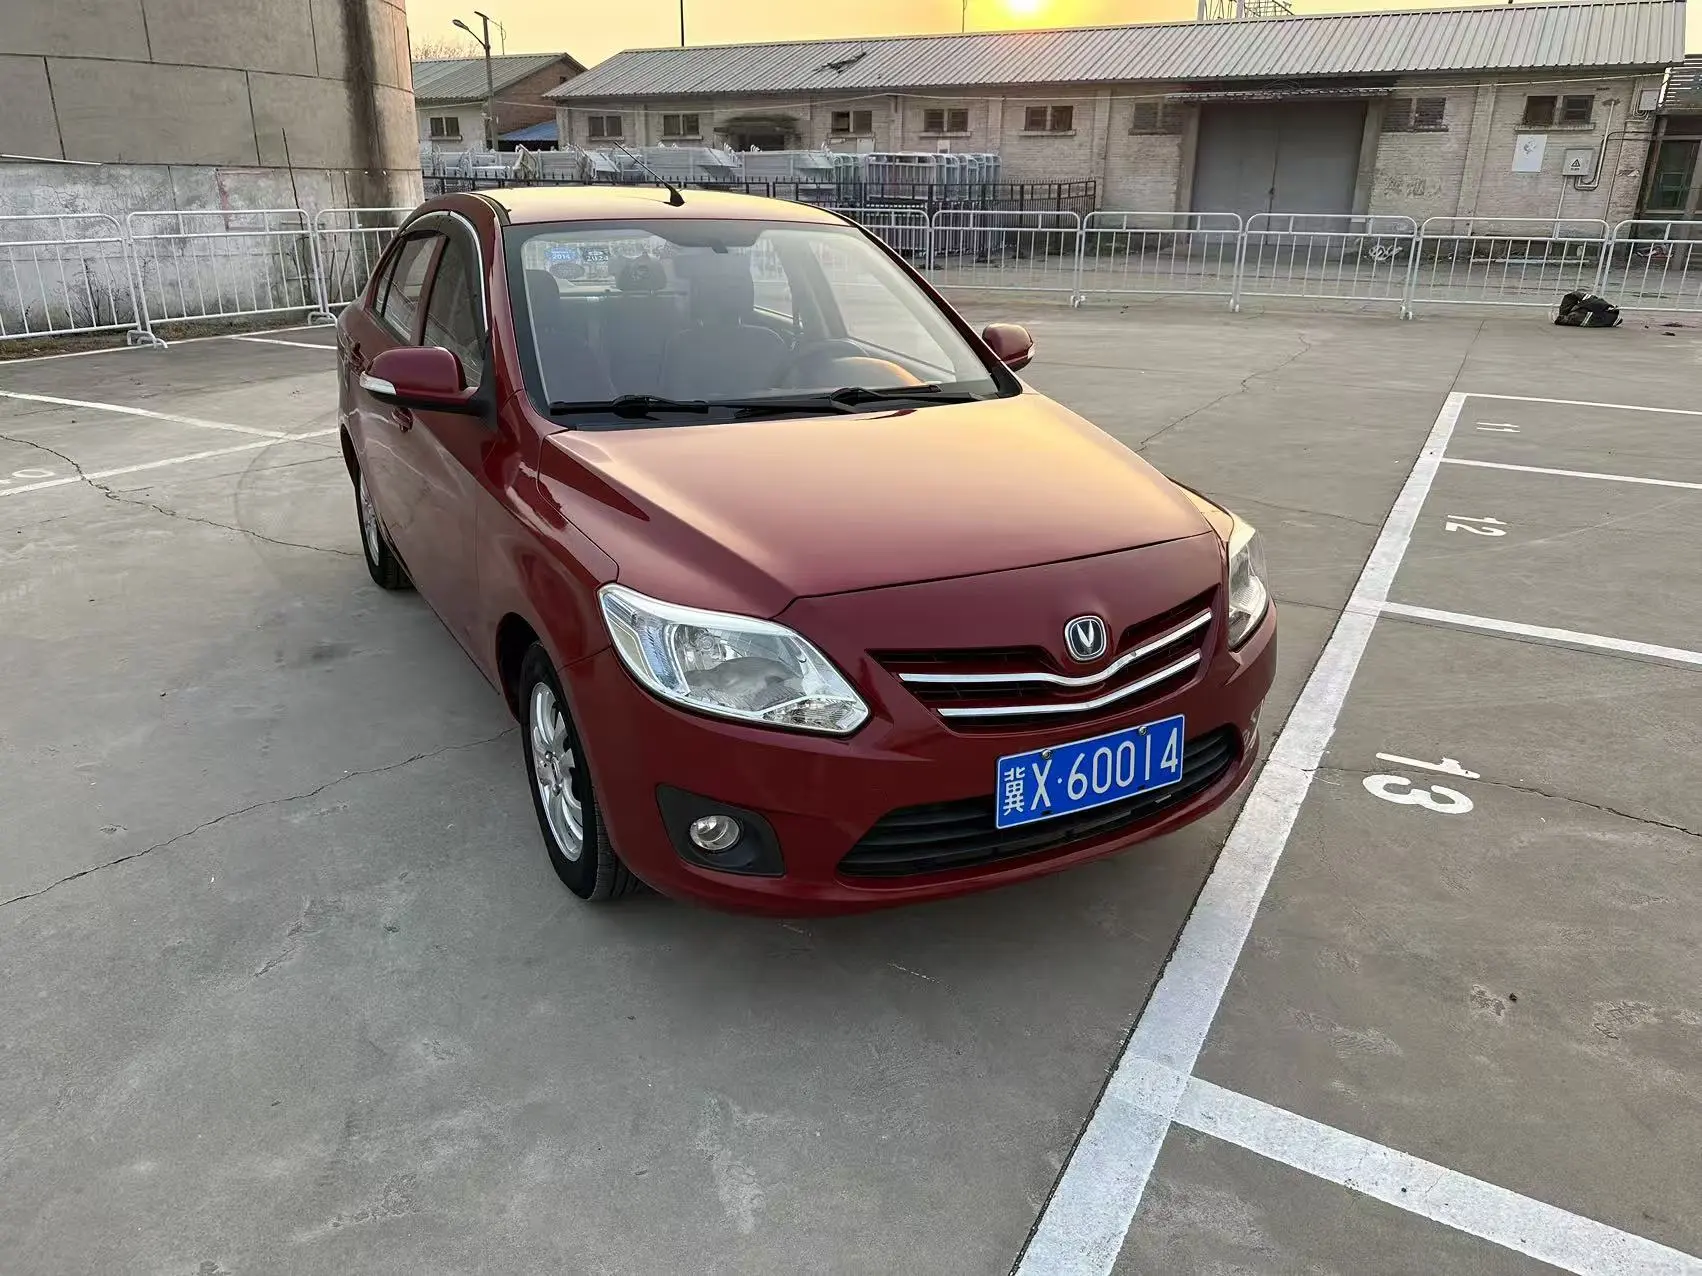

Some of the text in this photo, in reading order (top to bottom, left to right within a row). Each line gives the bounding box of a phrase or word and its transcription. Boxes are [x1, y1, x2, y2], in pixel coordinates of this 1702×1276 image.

[1475, 421, 1521, 433] 11
[1445, 514, 1507, 537] 12
[1362, 752, 1480, 814] 13
